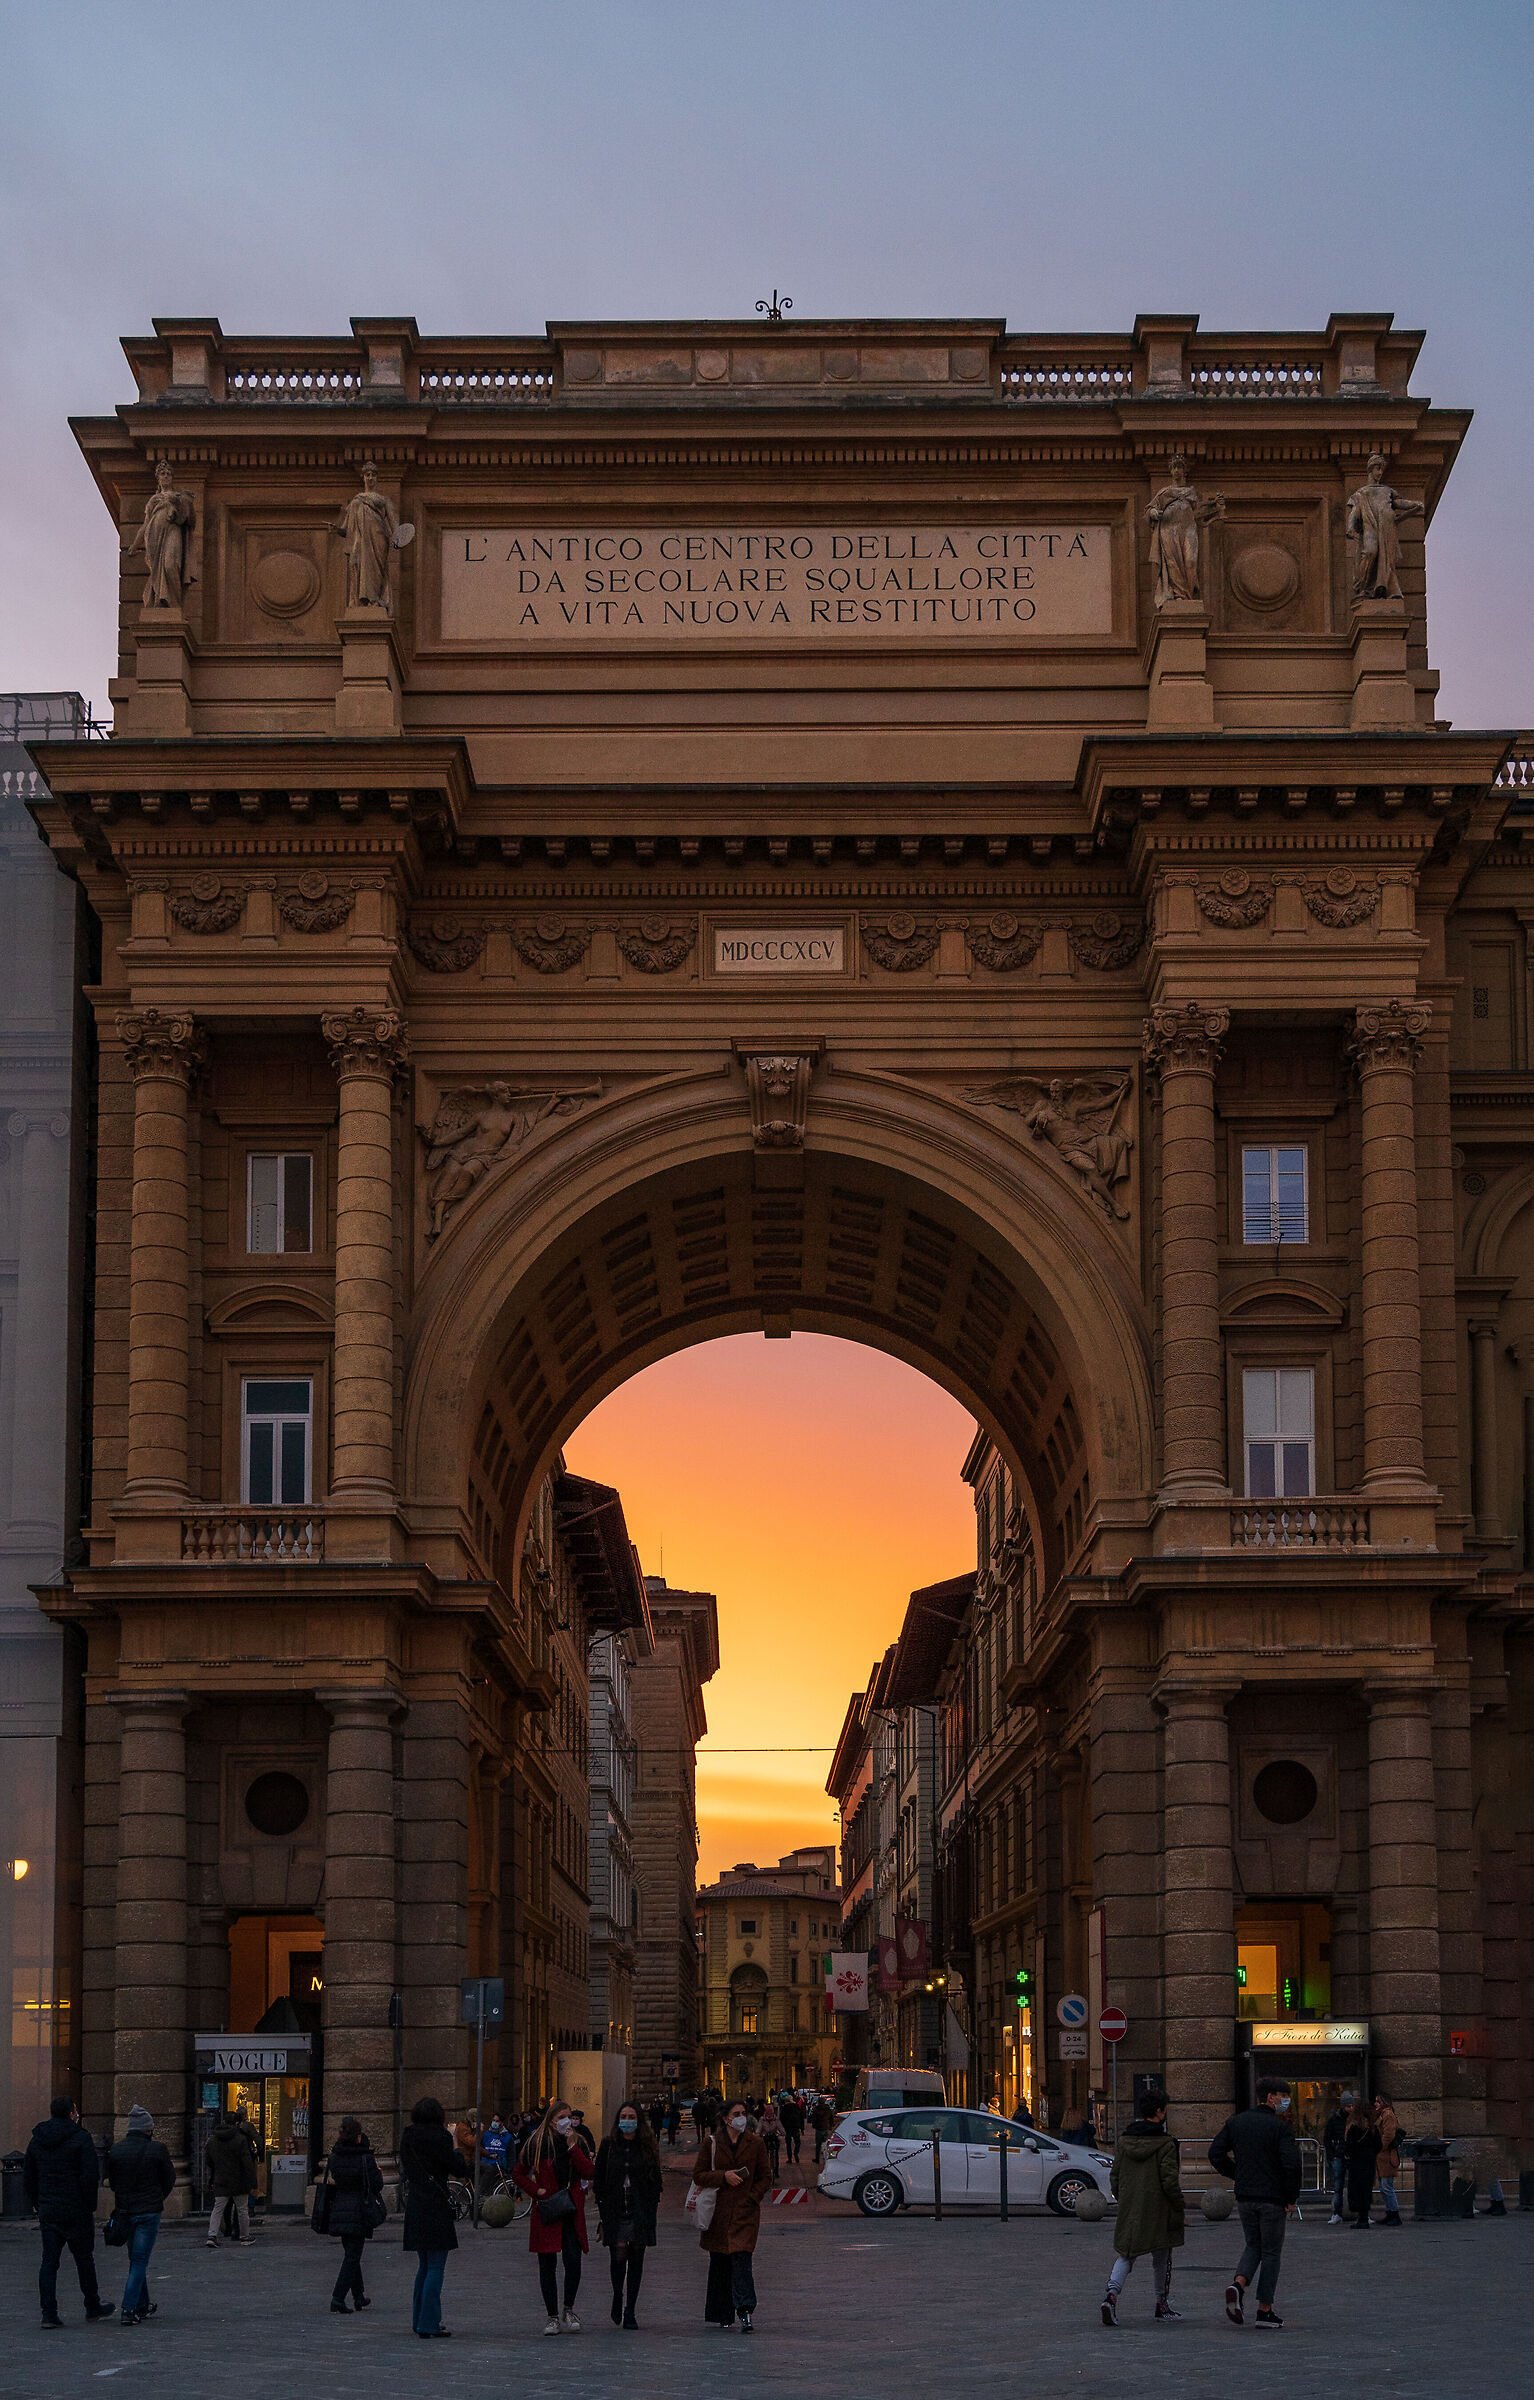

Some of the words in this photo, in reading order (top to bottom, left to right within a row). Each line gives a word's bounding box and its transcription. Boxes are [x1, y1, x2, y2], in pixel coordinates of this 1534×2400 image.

[505, 536, 643, 562] ANTICO
[659, 535, 814, 561] CENTRO
[831, 534, 960, 560] DELLA
[517, 568, 568, 594] DA
[583, 567, 788, 594] SECOLARE
[804, 566, 1036, 594] SQUALLORE
[517, 600, 541, 626] A
[557, 599, 646, 625] VITA
[662, 599, 792, 625] NUOVA
[809, 597, 1037, 624] RESTITUITO
[721, 940, 836, 961] MDCCCXCV
[1271, 2028, 1309, 2041] Fiori
[1310, 2029, 1322, 2040] di
[1324, 2027, 1366, 2041] Katia
[217, 2052, 286, 2072] VOGUE
